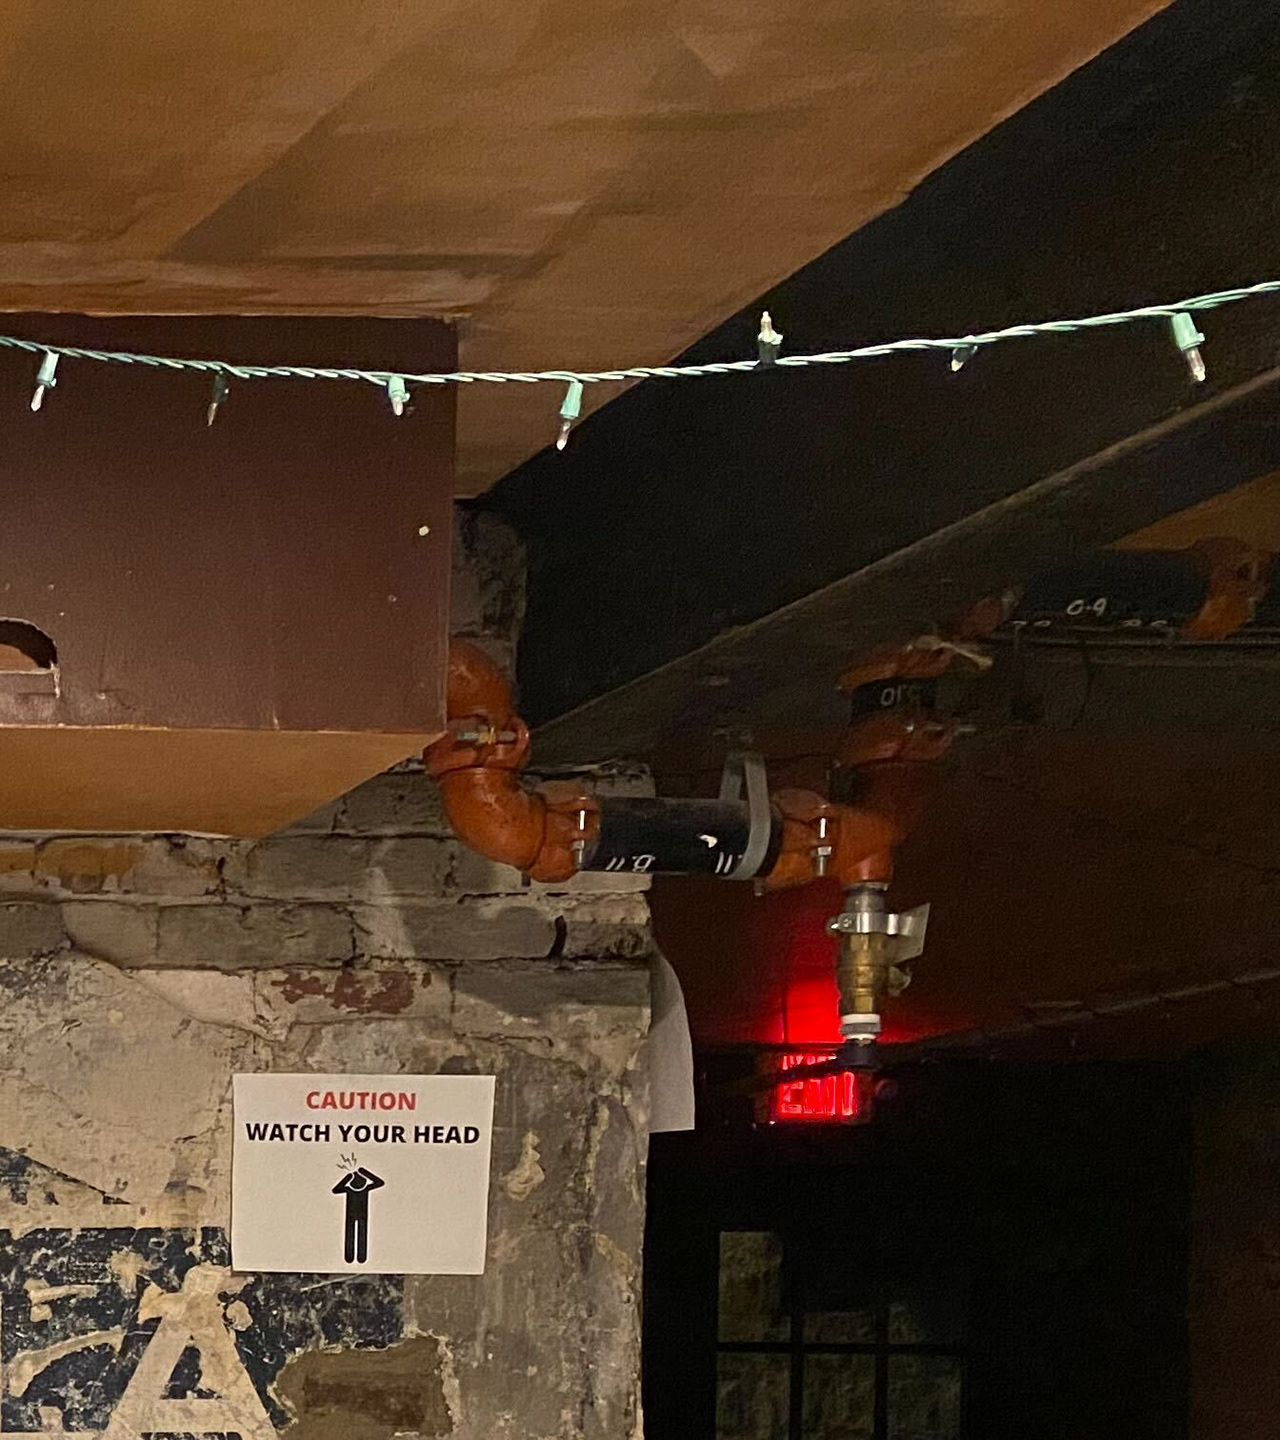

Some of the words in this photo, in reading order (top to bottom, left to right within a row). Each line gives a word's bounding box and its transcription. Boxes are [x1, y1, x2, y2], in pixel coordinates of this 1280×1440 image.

[305, 1090, 417, 1111] CAUTION
[246, 1123, 330, 1143] WATCH
[338, 1124, 407, 1144] YOUR
[413, 1125, 480, 1145] HEAD
